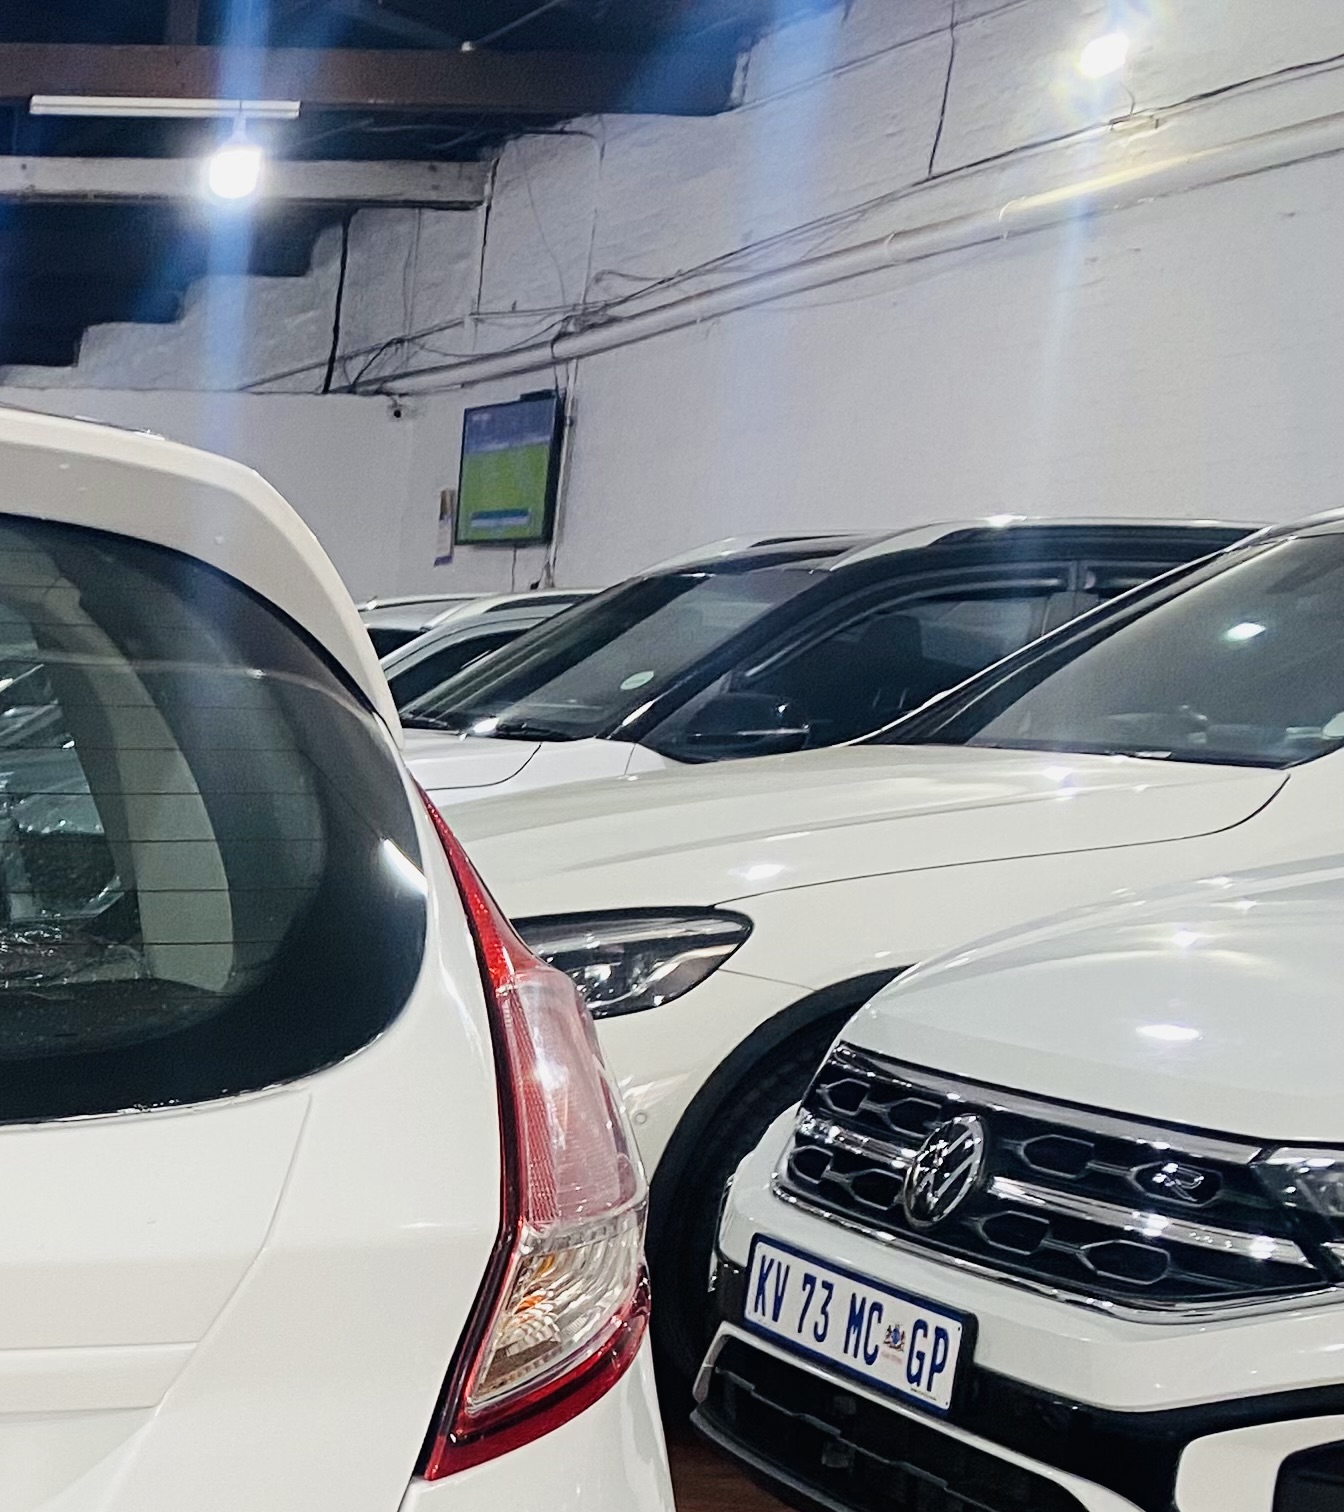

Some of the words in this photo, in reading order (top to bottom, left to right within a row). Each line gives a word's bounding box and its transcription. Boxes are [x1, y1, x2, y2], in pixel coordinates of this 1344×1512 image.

[754, 1254, 790, 1323] KV
[797, 1273, 834, 1343] 73
[843, 1292, 884, 1366] MC
[906, 1318, 950, 1393] GP
